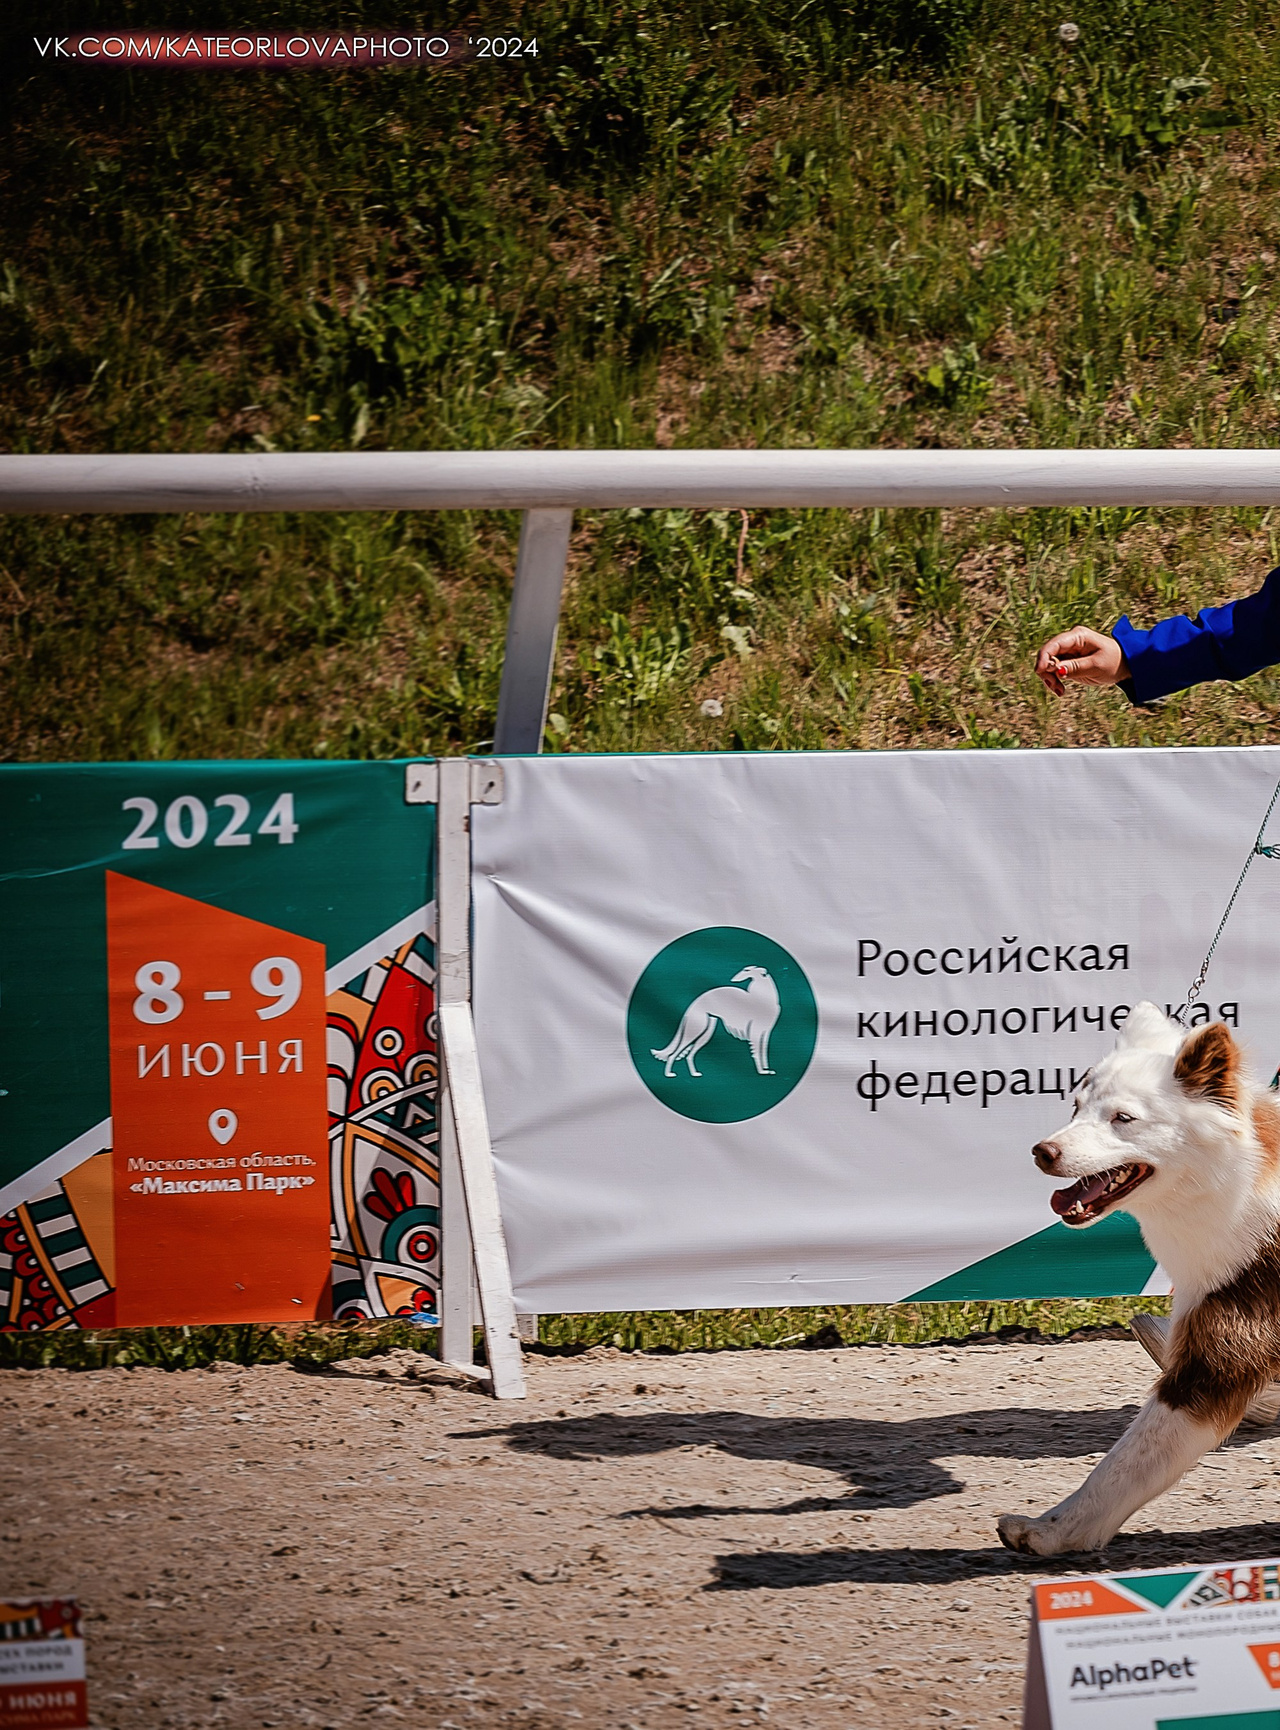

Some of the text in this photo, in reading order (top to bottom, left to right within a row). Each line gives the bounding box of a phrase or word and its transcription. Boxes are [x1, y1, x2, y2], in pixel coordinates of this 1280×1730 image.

[121, 792, 299, 850] 2024
[856, 935, 1130, 978] Российская
[856, 1001, 1240, 1038] кинологичекая
[136, 1038, 305, 1079] ИЮНЯ
[856, 1059, 1094, 1112] федераци
[127, 1156, 236, 1172] Московская
[129, 1172, 316, 1196] «Максима Парк»
[1049, 1589, 1095, 1610] 2024
[1069, 1656, 1198, 1690] AlphaPet
